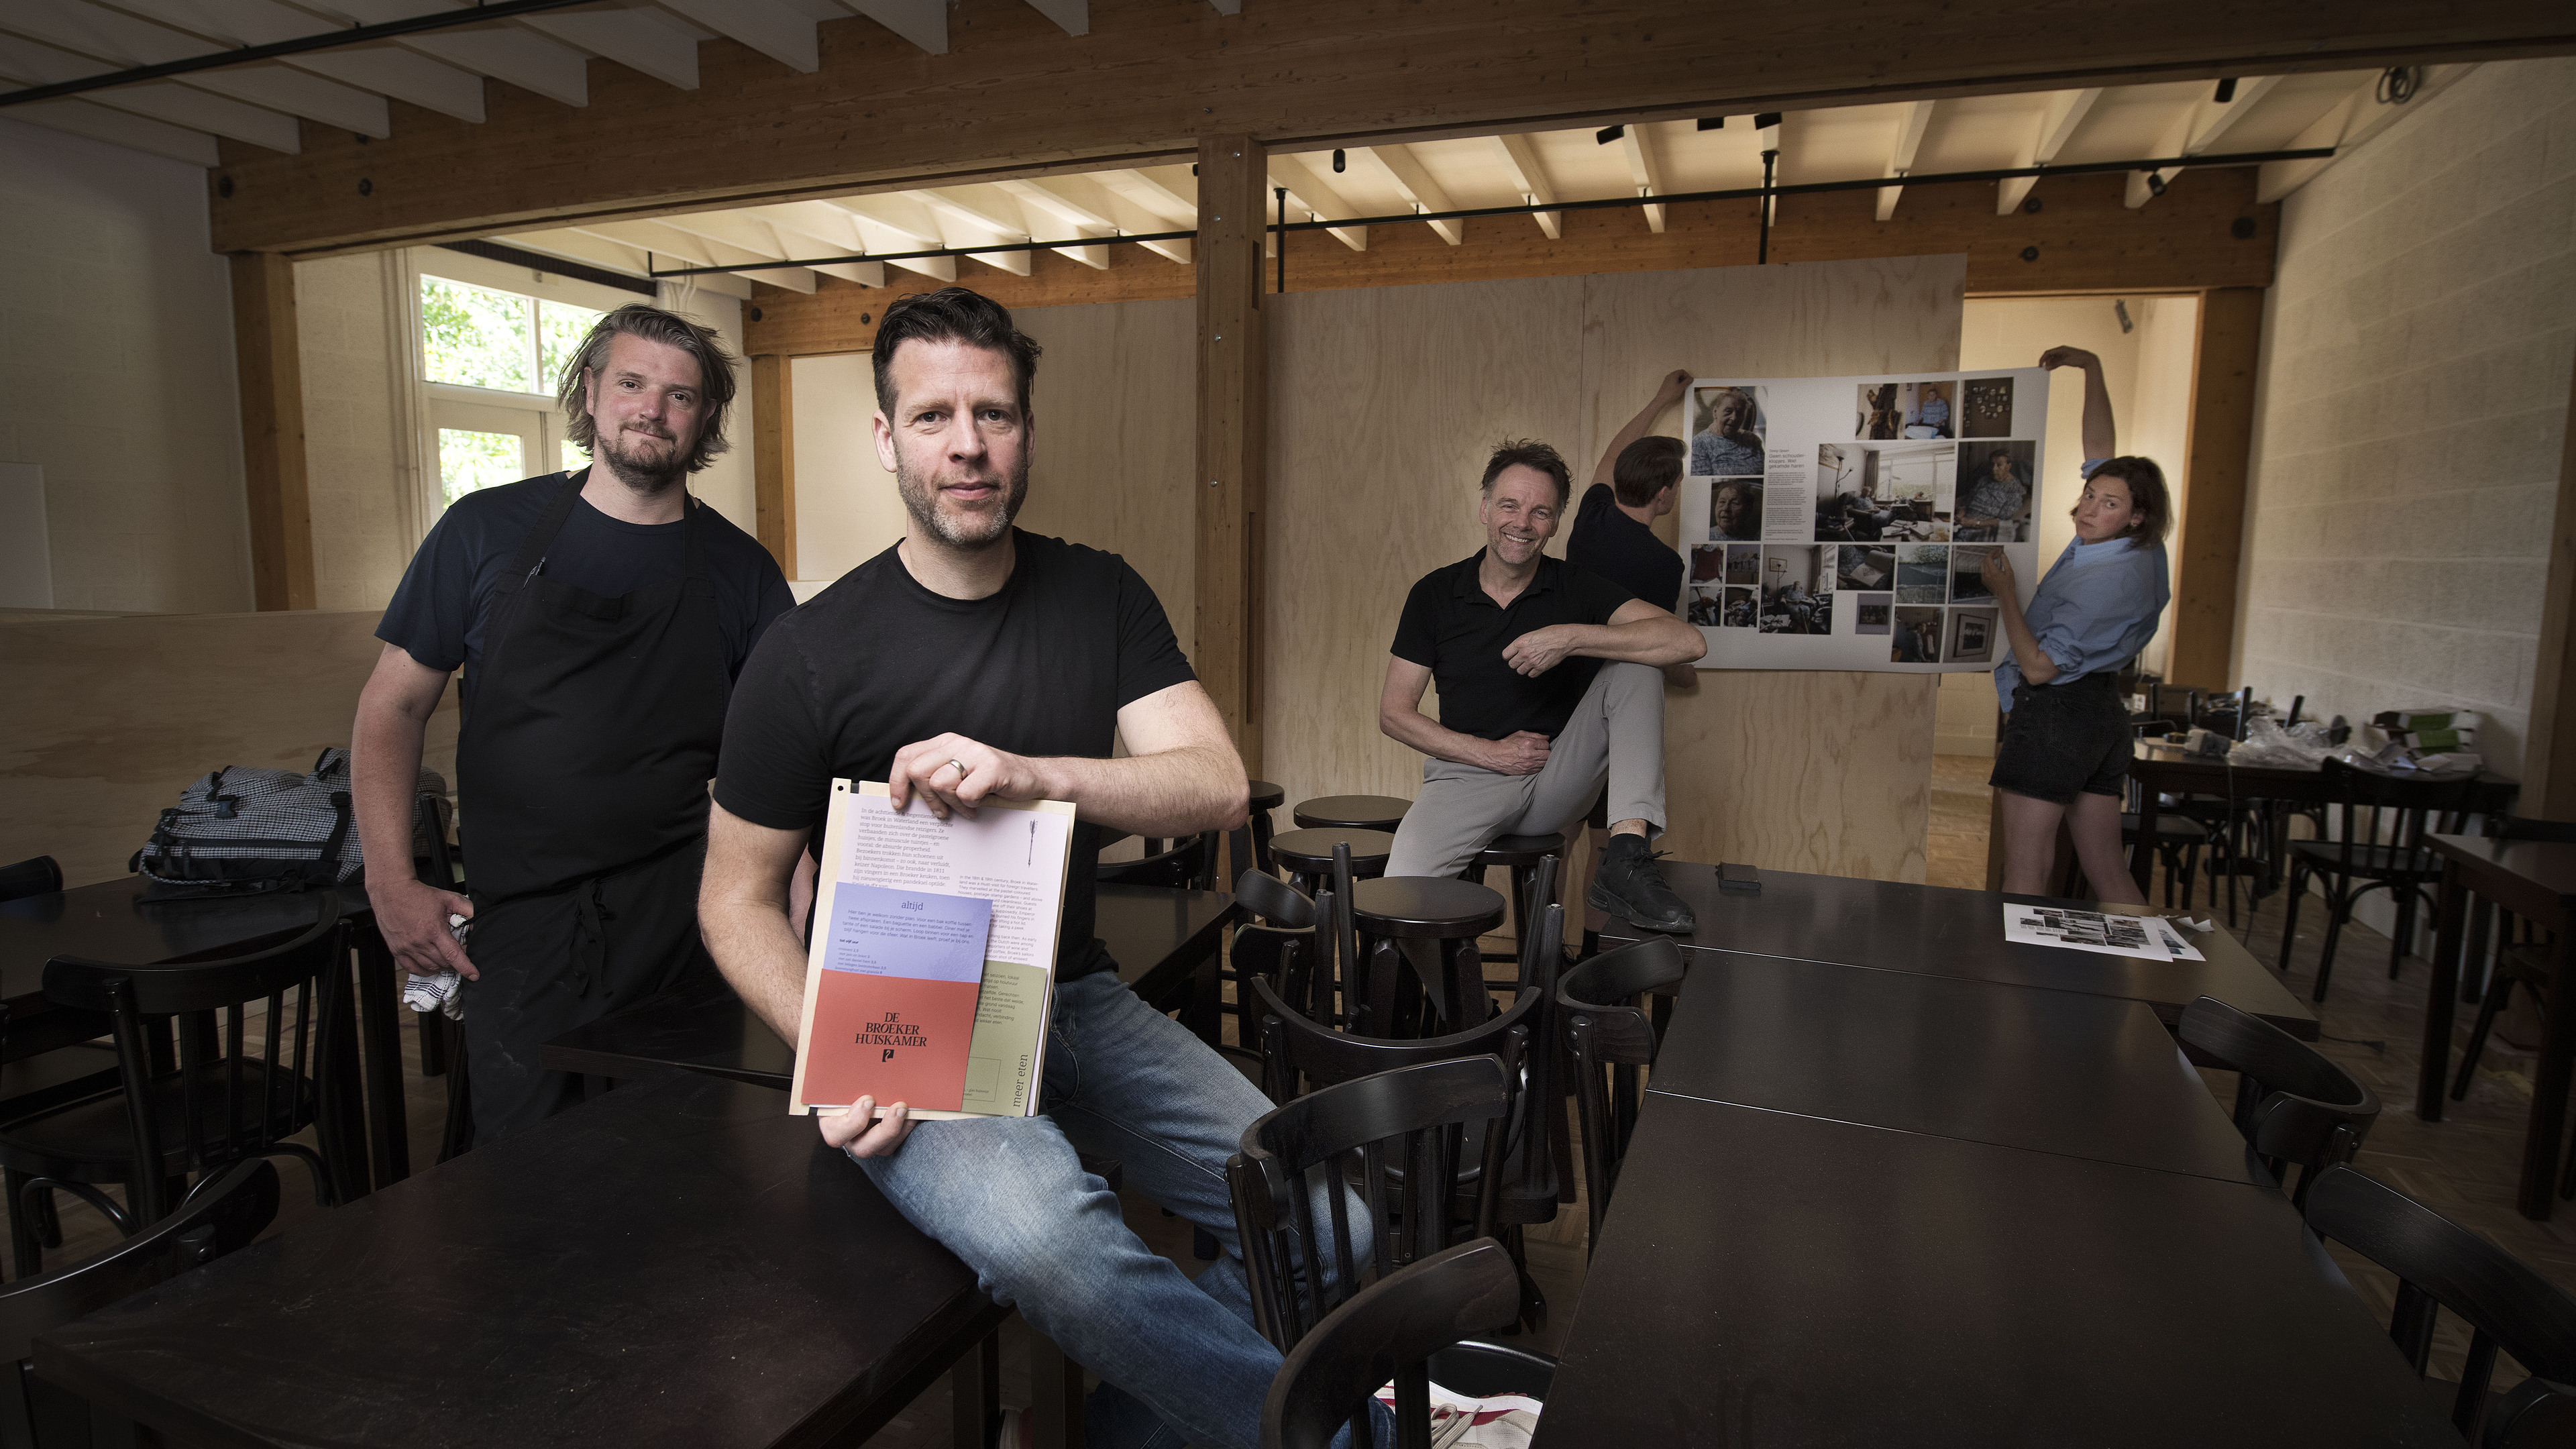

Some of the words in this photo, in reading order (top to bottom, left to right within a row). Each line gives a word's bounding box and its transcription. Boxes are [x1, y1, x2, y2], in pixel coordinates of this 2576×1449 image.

[901, 901, 924, 912] altijd
[884, 1012, 900, 1022] DE
[865, 1022, 920, 1035] BROEKER
[855, 1033, 927, 1047] HUISKAMER
[1018, 1054, 1028, 1077] eten
[1013, 1079, 1024, 1108] meer
